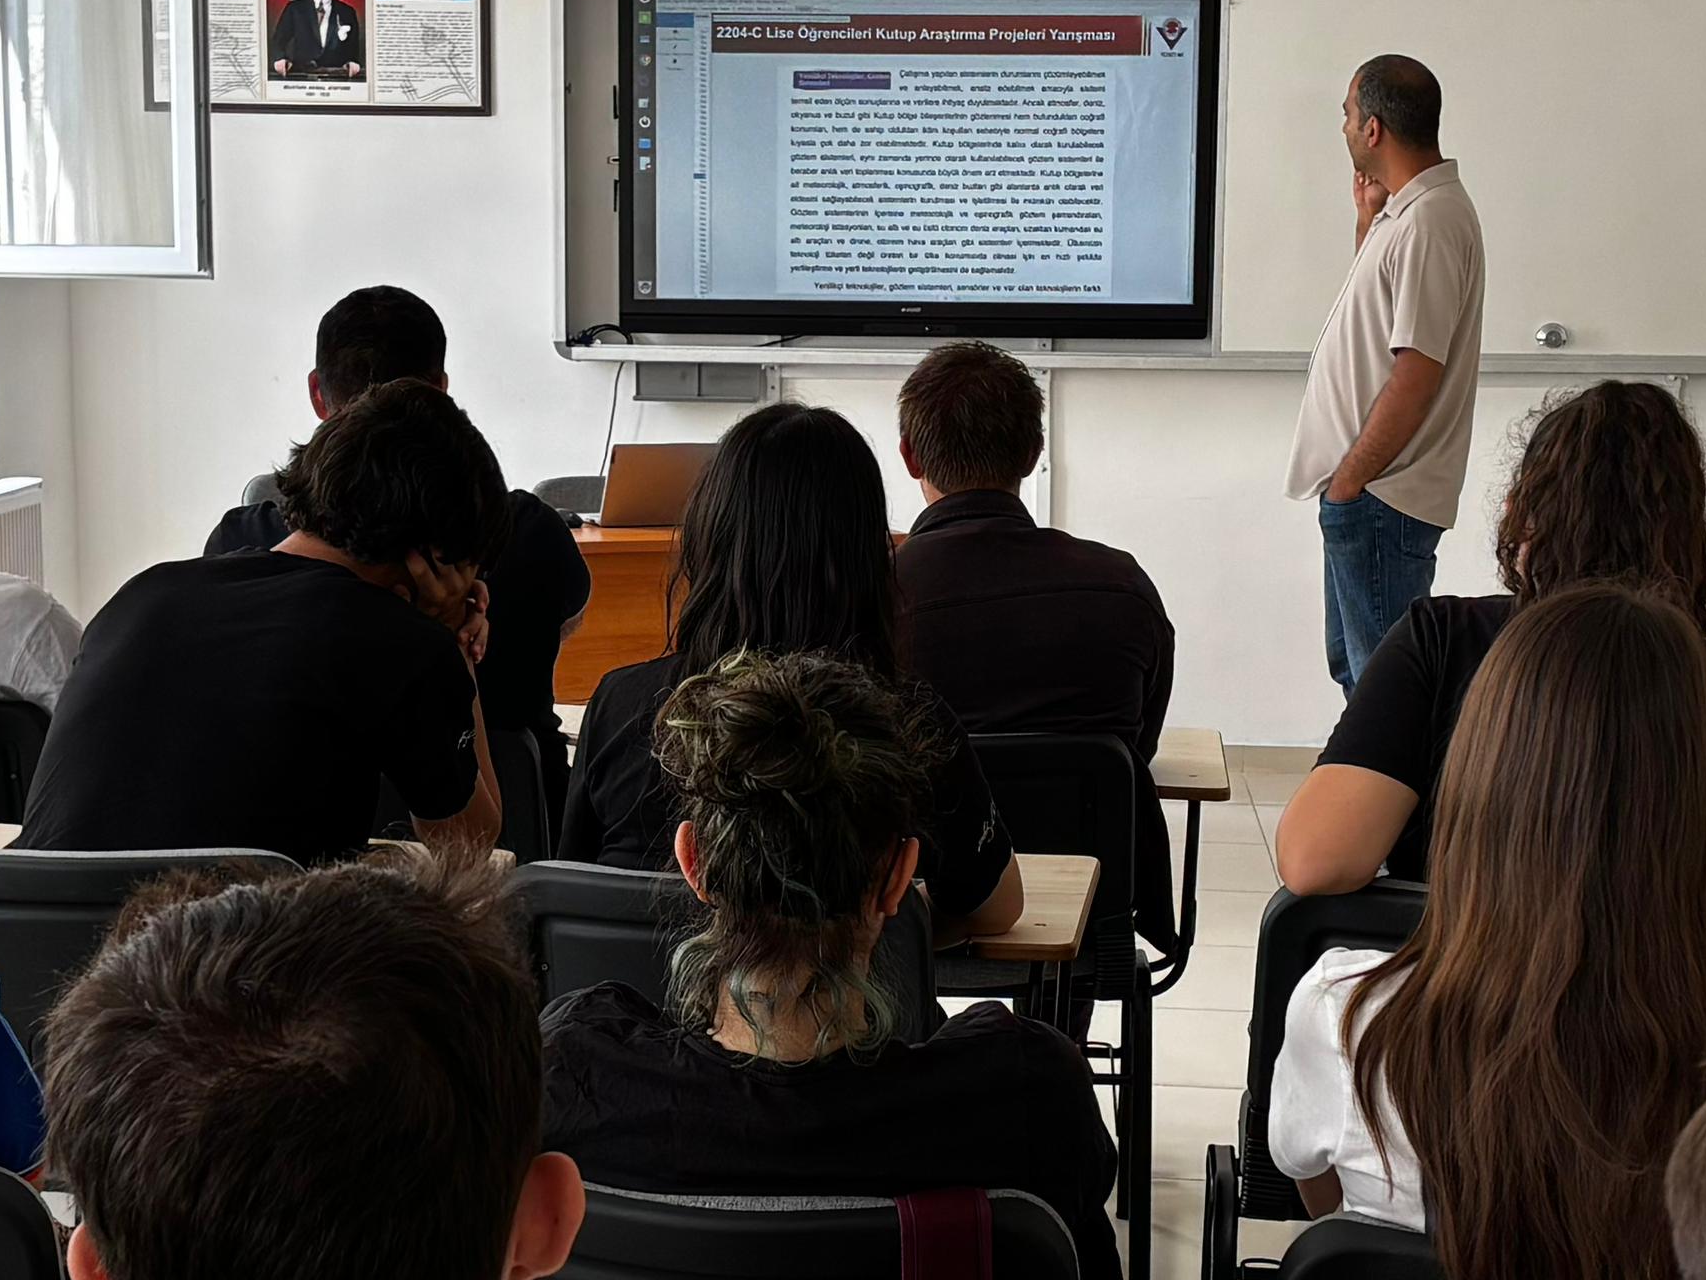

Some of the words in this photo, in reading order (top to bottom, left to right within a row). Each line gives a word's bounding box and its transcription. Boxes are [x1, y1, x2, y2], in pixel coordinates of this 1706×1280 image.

[716, 26, 762, 39] 2204-C
[766, 26, 794, 39] Lise
[798, 24, 872, 42] Öğrencileri
[876, 27, 917, 42] Kutup
[919, 28, 986, 43] Araştırma
[989, 28, 1046, 43] Projeleri
[1049, 28, 1116, 43] Yarışması
